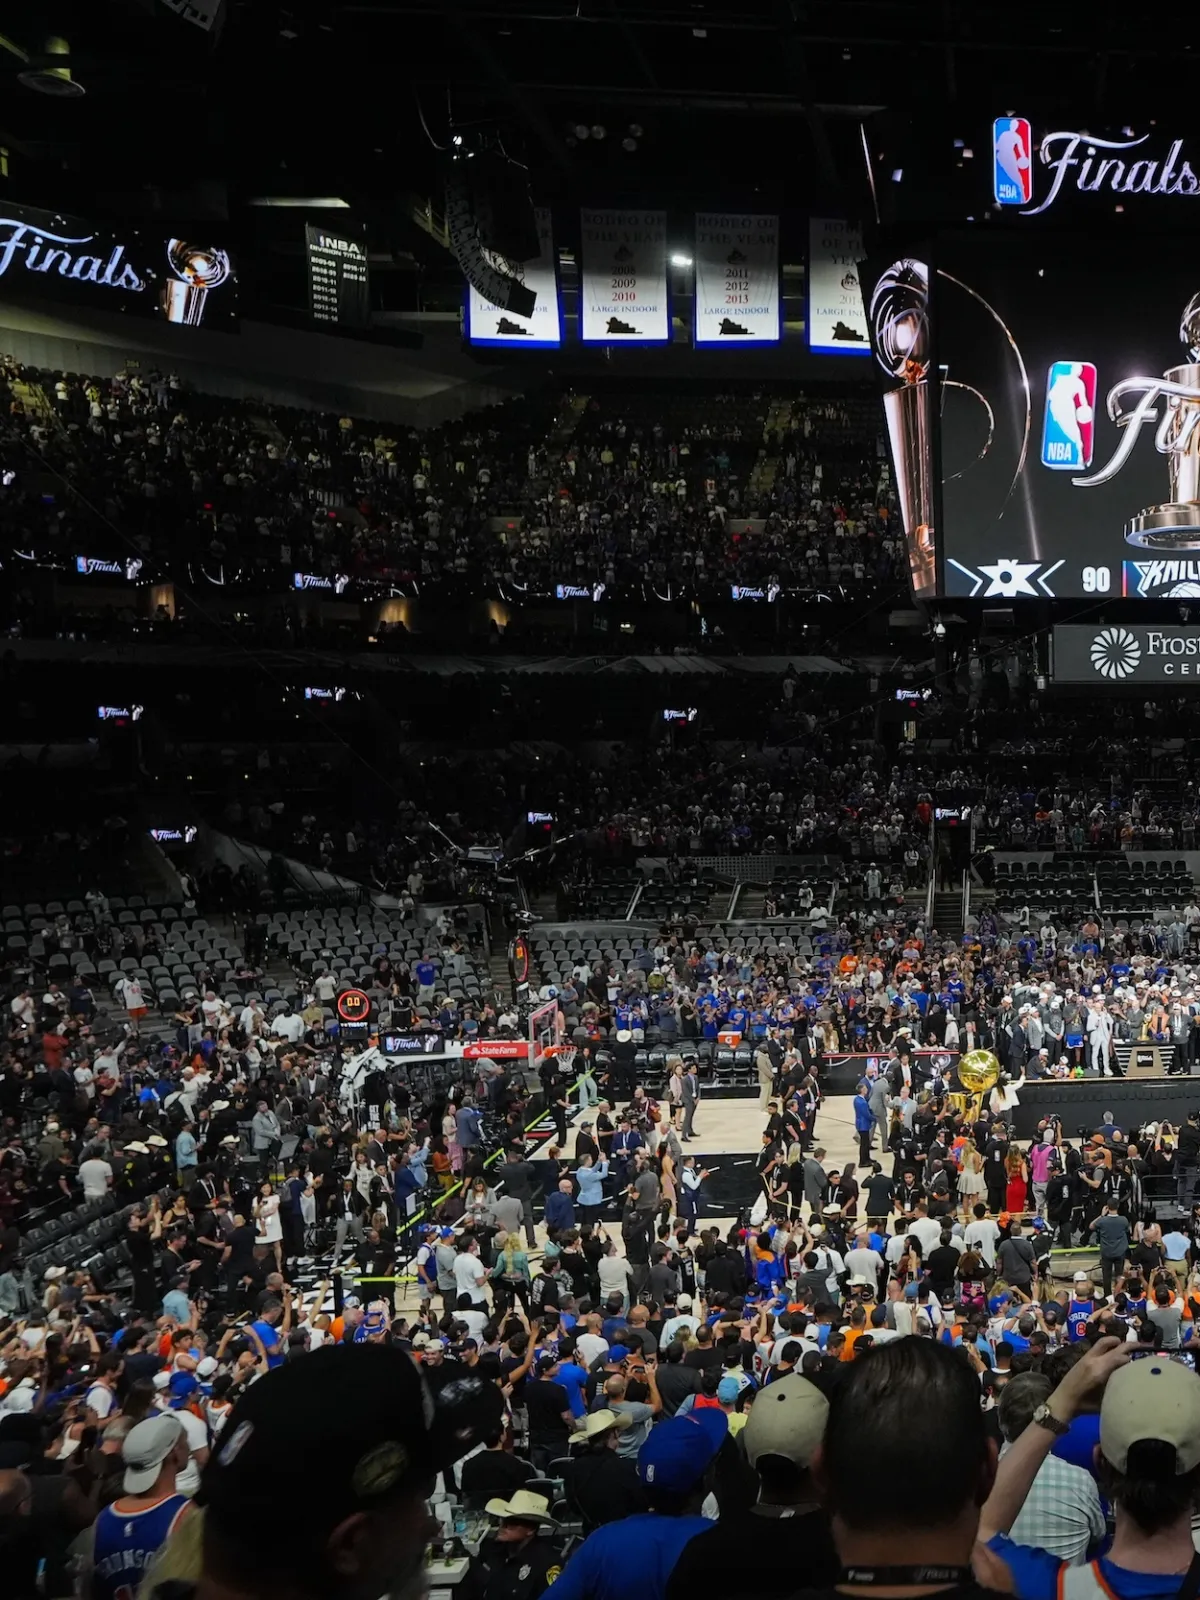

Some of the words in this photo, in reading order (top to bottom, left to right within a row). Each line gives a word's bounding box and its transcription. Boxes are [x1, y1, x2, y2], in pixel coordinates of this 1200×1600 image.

[310, 244, 342, 256] DIVISION
[325, 237, 360, 254] NBA
[725, 268, 748, 278] 2011
[611, 279, 636, 289] 2009
[725, 281, 749, 291] 2012
[611, 292, 636, 302] 2010
[725, 294, 749, 304] 2013
[592, 305, 620, 313] LARGE
[622, 305, 658, 313] INDOOR
[704, 307, 732, 315] LARGE
[735, 307, 769, 315] INDOOR
[1047, 441, 1072, 462] NBA
[85, 558, 122, 575] Finals
[302, 575, 332, 590] Finals
[1082, 566, 1111, 593] 90
[562, 586, 590, 600] Finals
[738, 586, 765, 599] Finals
[155, 829, 183, 842] Finals
[346, 997, 361, 1007] 0.0
[393, 1038, 422, 1053] Finals
[1075, 1322, 1087, 1337] 8
